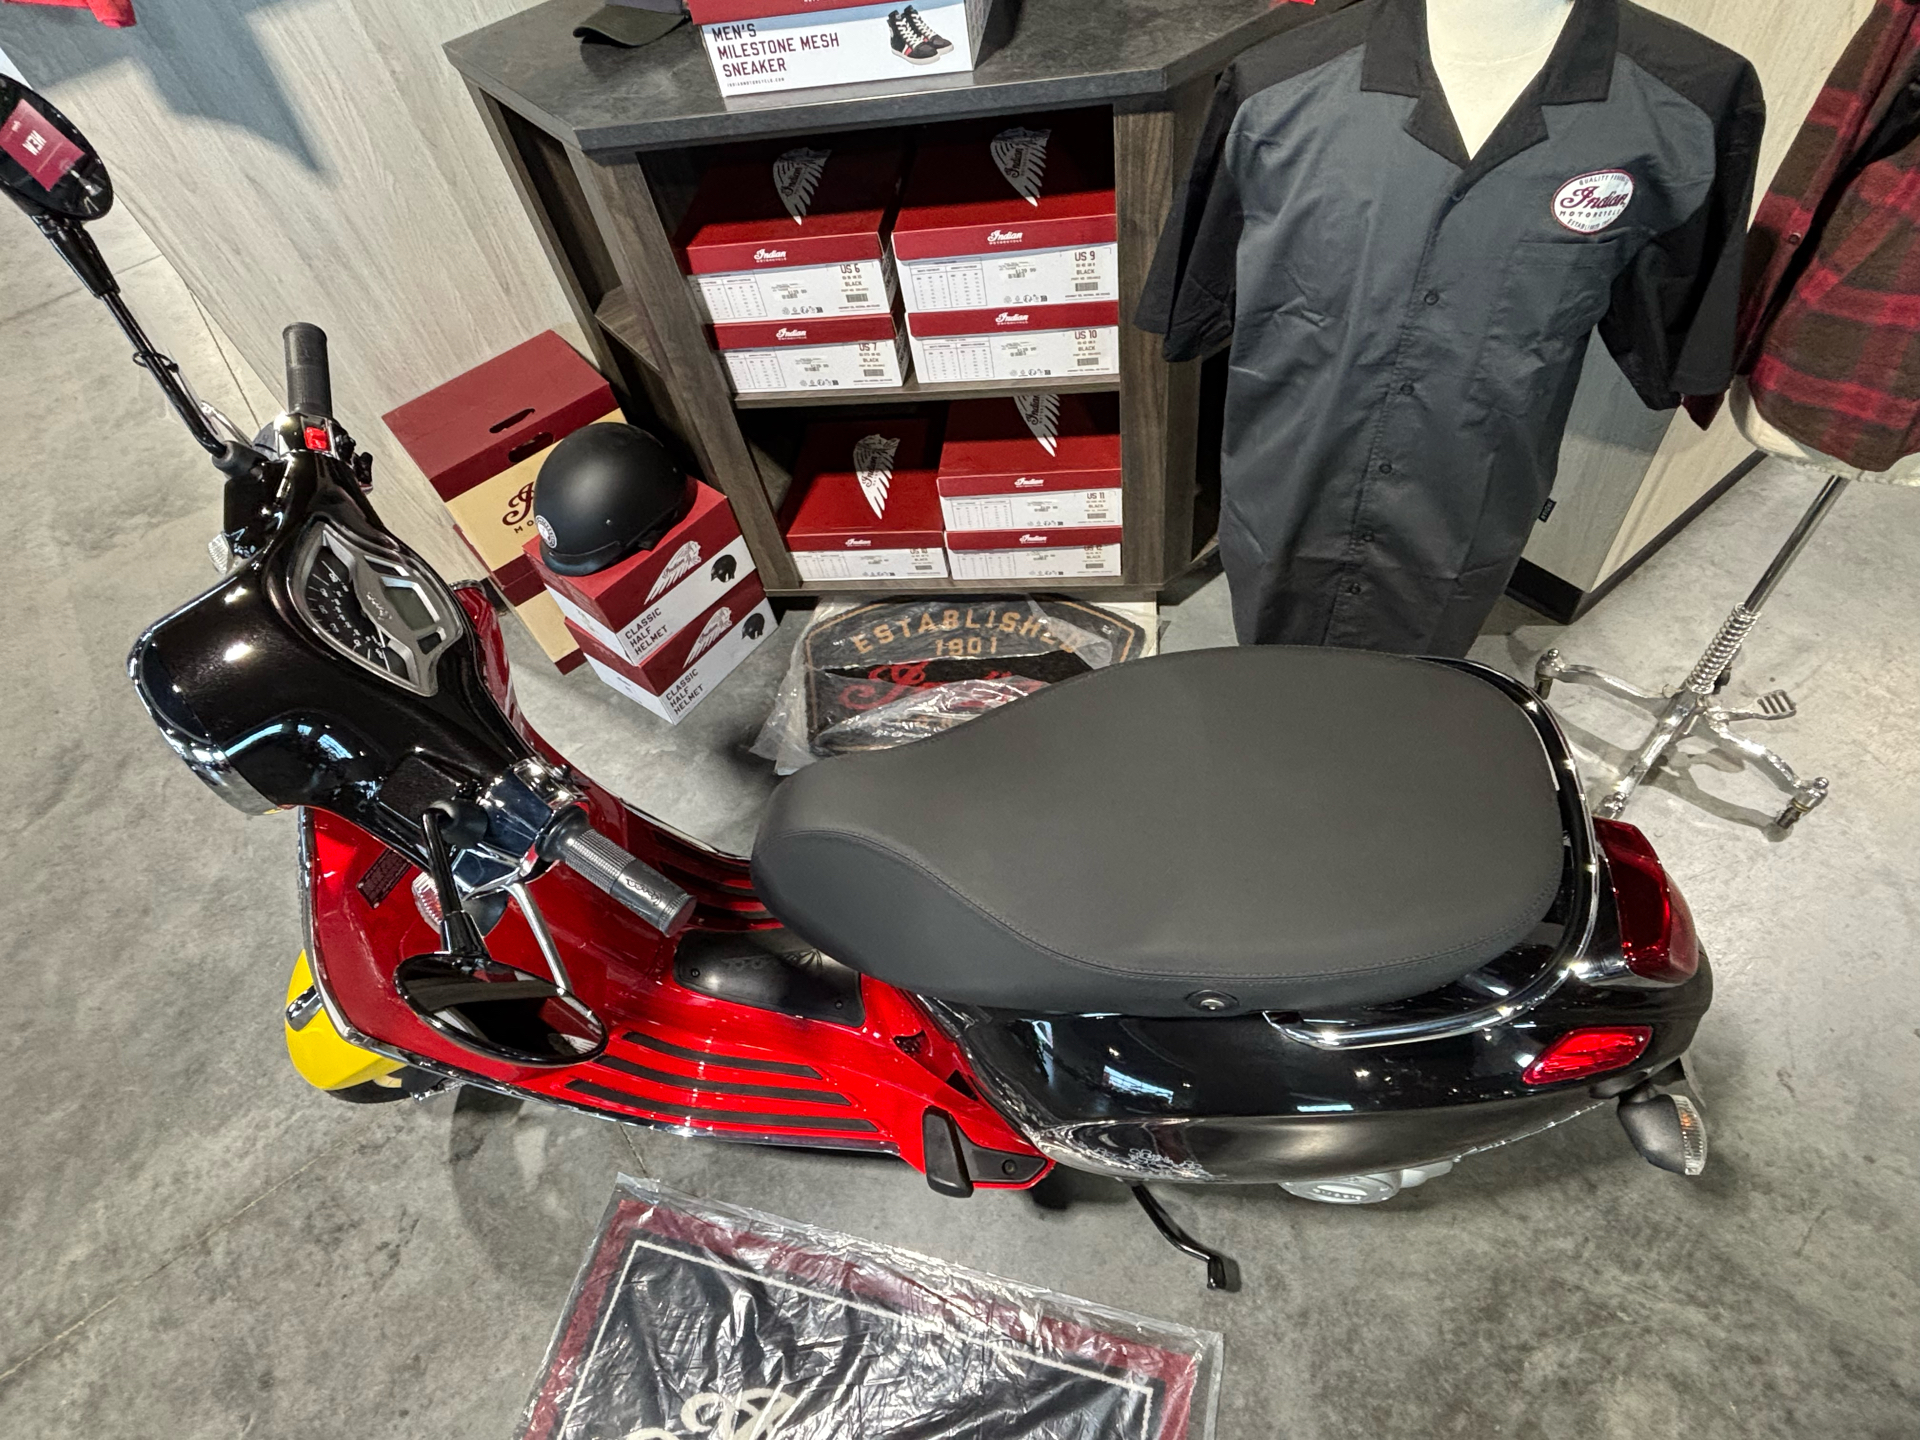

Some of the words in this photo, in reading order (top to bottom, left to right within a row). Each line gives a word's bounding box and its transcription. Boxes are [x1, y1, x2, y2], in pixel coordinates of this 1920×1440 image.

[712, 23, 757, 42] MEN'S
[717, 37, 797, 60] MILESTONE
[799, 32, 840, 51] MESH
[722, 57, 787, 78] SNEAKER
[1560, 186, 1630, 209] Indian
[987, 229, 1024, 242] Indian
[753, 248, 787, 260] Indian
[1074, 251, 1087, 261] US
[1089, 250, 1096, 261] 9
[840, 264, 853, 274] US
[995, 312, 1029, 323] Indian
[775, 327, 807, 338] Indian
[1074, 330, 1087, 340] US
[1089, 329, 1098, 339] 10
[859, 342, 871, 352] US
[1086, 492, 1098, 500] US
[625, 607, 662, 640] CLASSIC
[630, 625, 652, 648] HALF
[634, 624, 669, 656] HELMET
[935, 636, 998, 656] 1901
[665, 668, 699, 701] CLASSIC
[670, 686, 690, 709] HALF
[674, 684, 705, 716] HELMET
